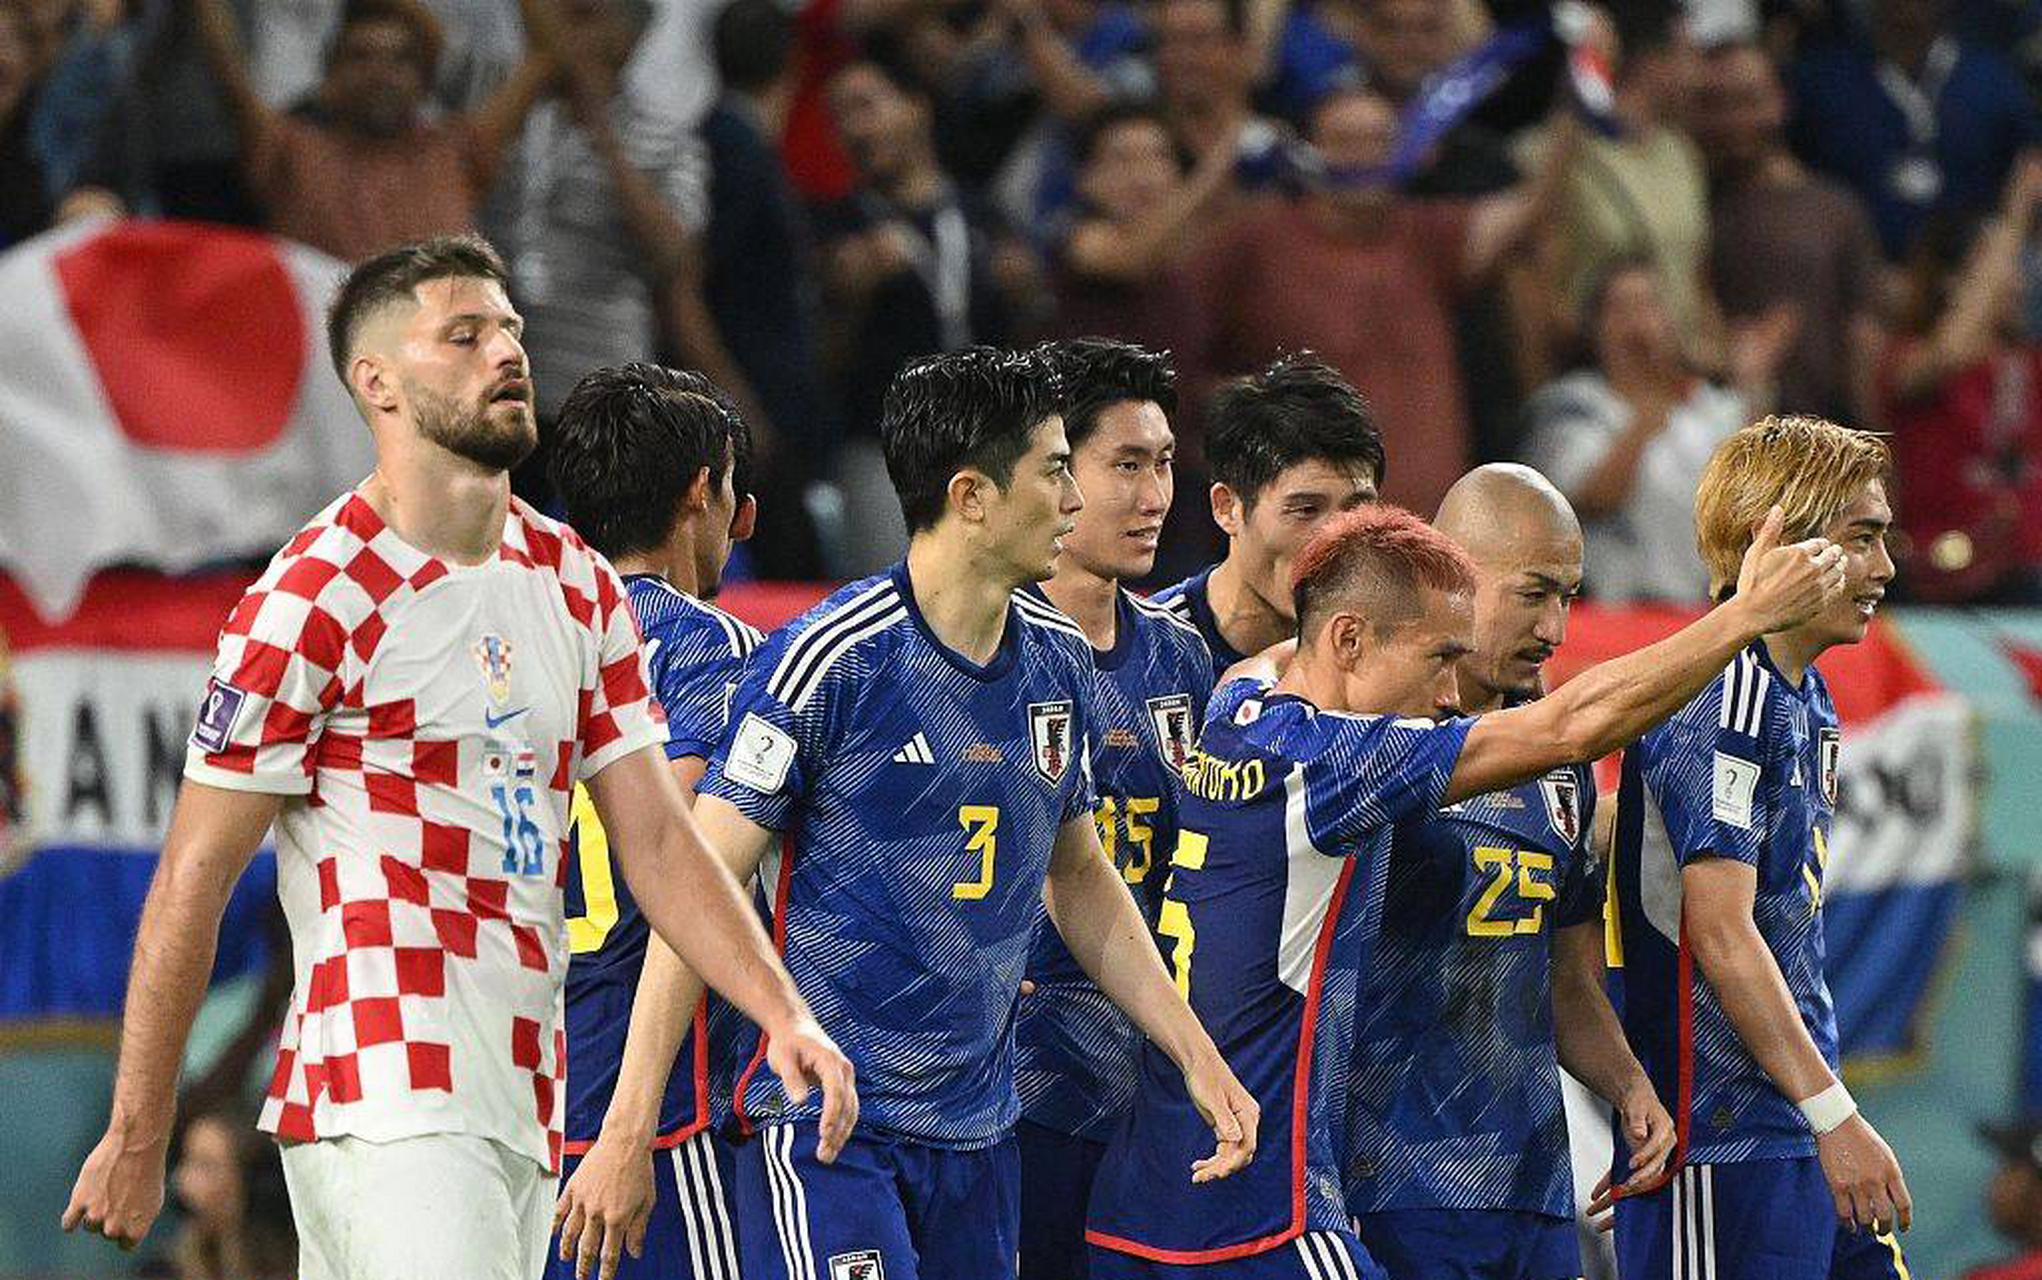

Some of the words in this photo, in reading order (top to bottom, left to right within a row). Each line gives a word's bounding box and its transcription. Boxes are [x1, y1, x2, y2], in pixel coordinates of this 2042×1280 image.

[491, 785, 545, 876] 16
[951, 805, 1000, 899] 3
[1093, 796, 1160, 884] 15
[1467, 846, 1557, 937] 25
